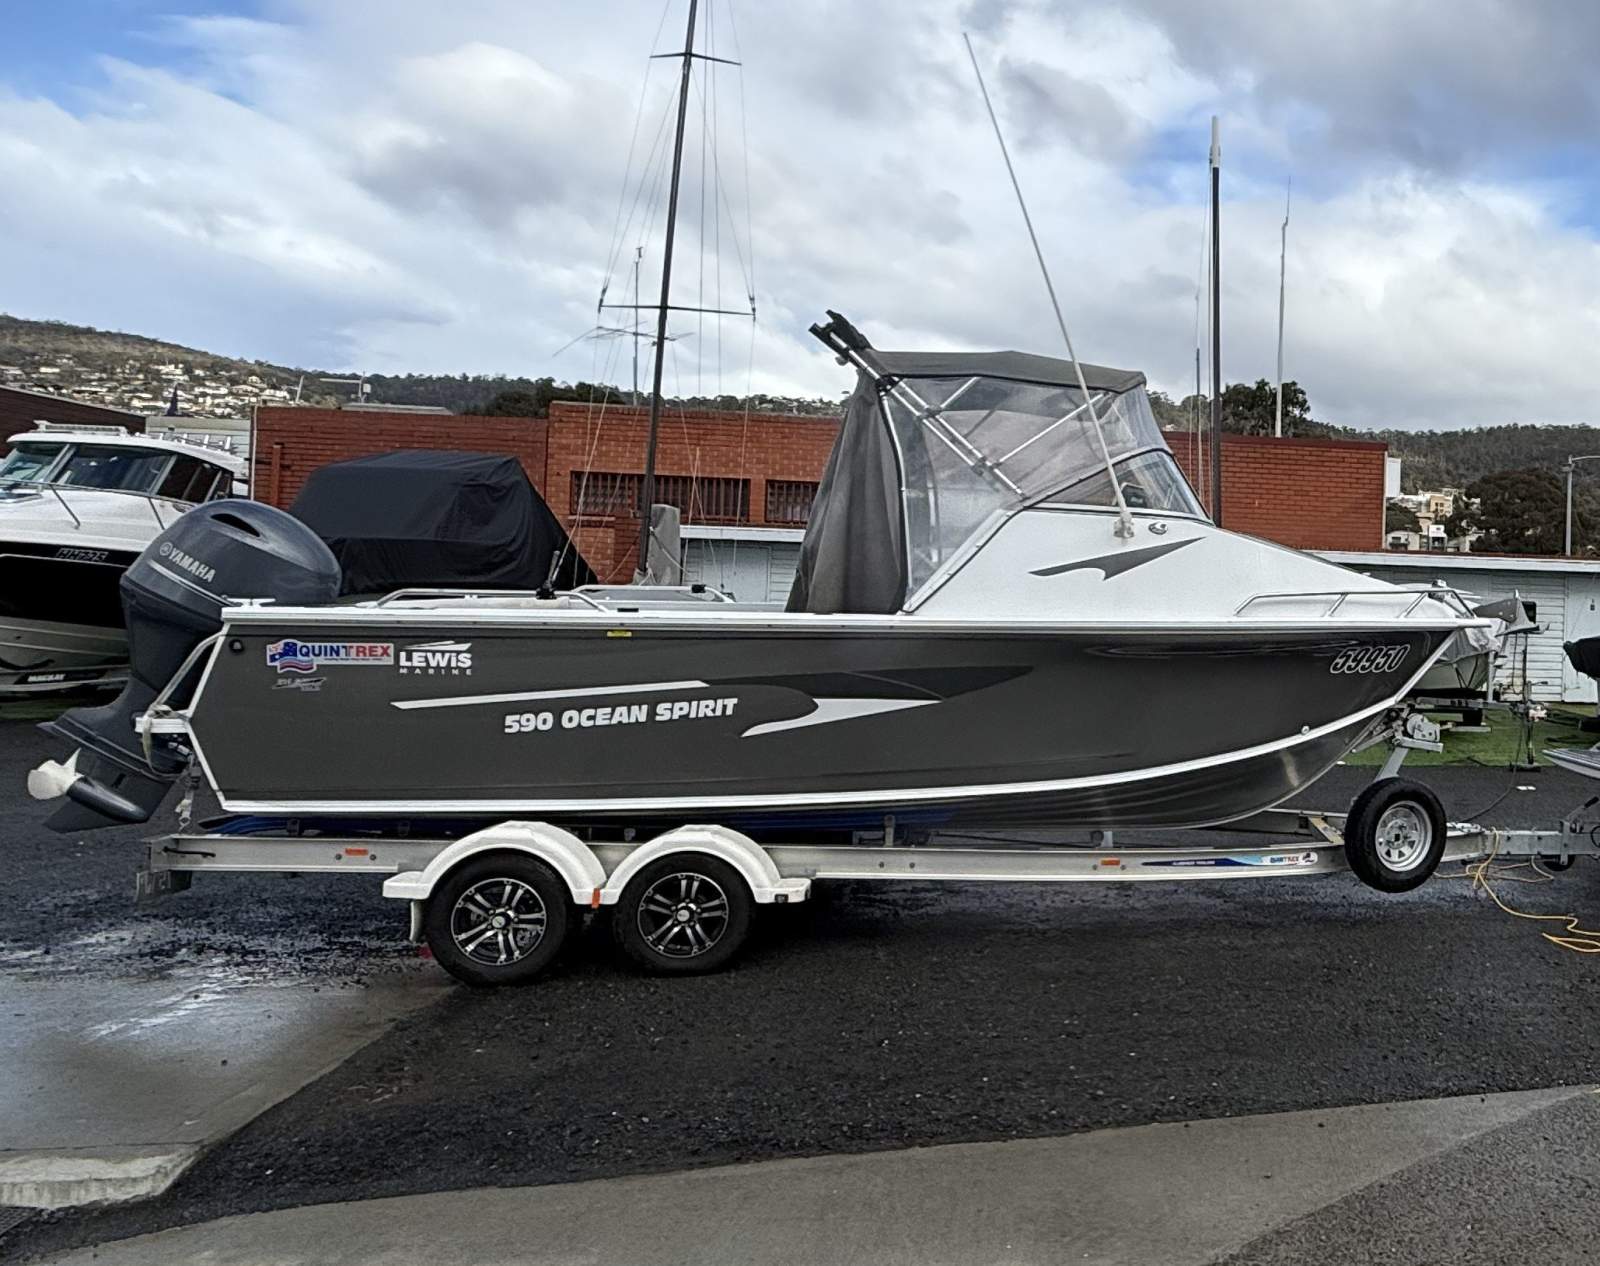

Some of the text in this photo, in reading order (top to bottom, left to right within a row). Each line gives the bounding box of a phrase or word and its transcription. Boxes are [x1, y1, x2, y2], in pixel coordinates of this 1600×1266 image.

[168, 547, 216, 583] YAMAHA
[297, 644, 391, 658] QUINTREX
[1329, 643, 1411, 674] 59950
[399, 668, 473, 676] MARINE
[504, 698, 738, 733] 590 OCEAN SPIRIT
